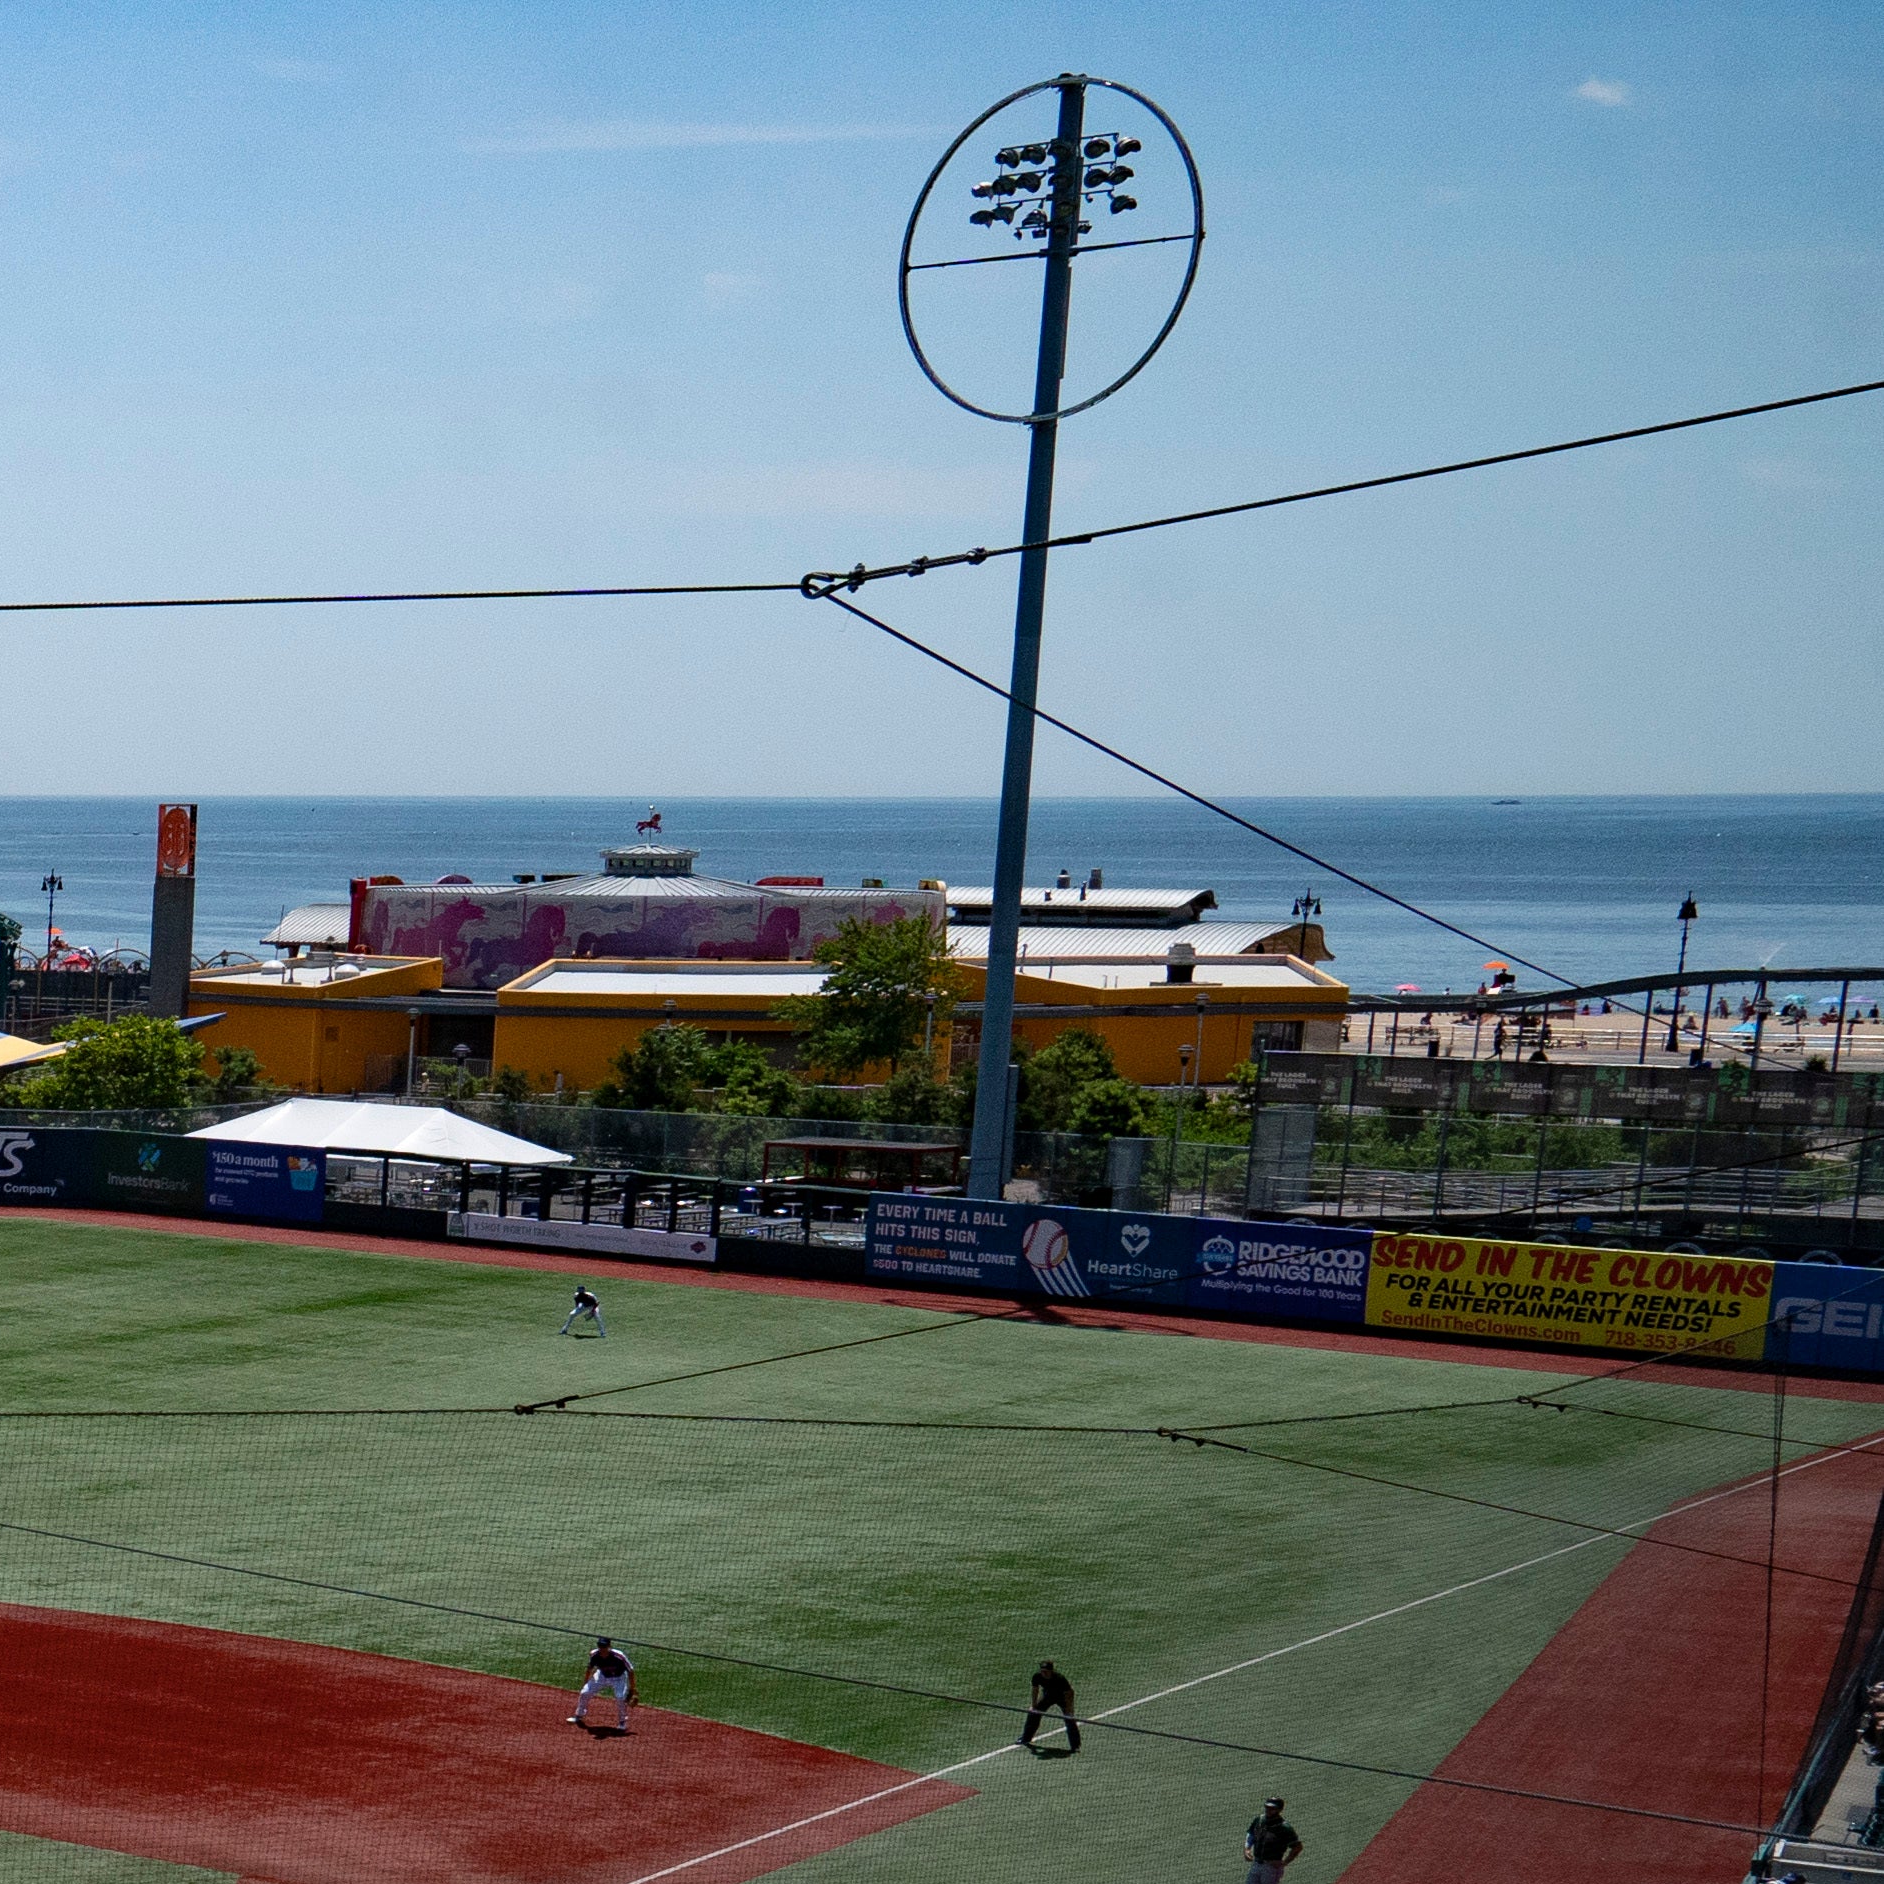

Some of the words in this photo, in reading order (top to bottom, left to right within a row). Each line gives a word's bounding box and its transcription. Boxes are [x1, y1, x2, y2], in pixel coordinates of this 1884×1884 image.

[235, 1156, 241, 1165] a
[243, 1155, 279, 1168] month
[3, 1184, 57, 1197] Company
[108, 1172, 188, 1192] InvestorsBank
[877, 1203, 919, 1219] EVERY
[923, 1207, 956, 1223] TIME
[960, 1210, 968, 1224] A
[973, 1212, 1007, 1227] BALL
[875, 1222, 905, 1237] HITS
[910, 1225, 940, 1240] THIS
[944, 1228, 980, 1245] SIGN,
[873, 1243, 892, 1254] THE
[895, 1245, 946, 1259] CYCLONES
[949, 1250, 974, 1262] WILL
[977, 1253, 1016, 1266] DONATE
[1238, 1241, 1364, 1269] RIDGEWOOD
[901, 1260, 913, 1271] TO
[915, 1262, 982, 1278] HEARTSHARE.
[1088, 1260, 1178, 1280] HeartShare
[1237, 1264, 1310, 1283] SAVINGS
[1313, 1269, 1362, 1287] BANK
[1373, 1236, 1466, 1273] SEND
[1475, 1245, 1518, 1277] IN
[1529, 1248, 1600, 1284] THE
[1609, 1255, 1773, 1298] CLOWNS
[1201, 1278, 1252, 1294] Multiplying
[1256, 1283, 1270, 1293] the
[1273, 1284, 1300, 1296] Good
[1302, 1286, 1315, 1296] for
[1318, 1288, 1333, 1299] 100
[1336, 1290, 1361, 1301] Years
[1386, 1273, 1431, 1292] FOR
[1435, 1278, 1476, 1297] ALL
[1482, 1282, 1545, 1301] YOUR
[1550, 1287, 1628, 1308] PARTY
[1631, 1294, 1741, 1318] RENTALS
[1408, 1292, 1423, 1308] &
[1428, 1294, 1624, 1325] ENTERTAINMENT
[1624, 1312, 1713, 1333] NEEDS!
[1774, 1297, 1884, 1339] GEI
[1382, 1309, 1580, 1341] SendInTheClowns.com
